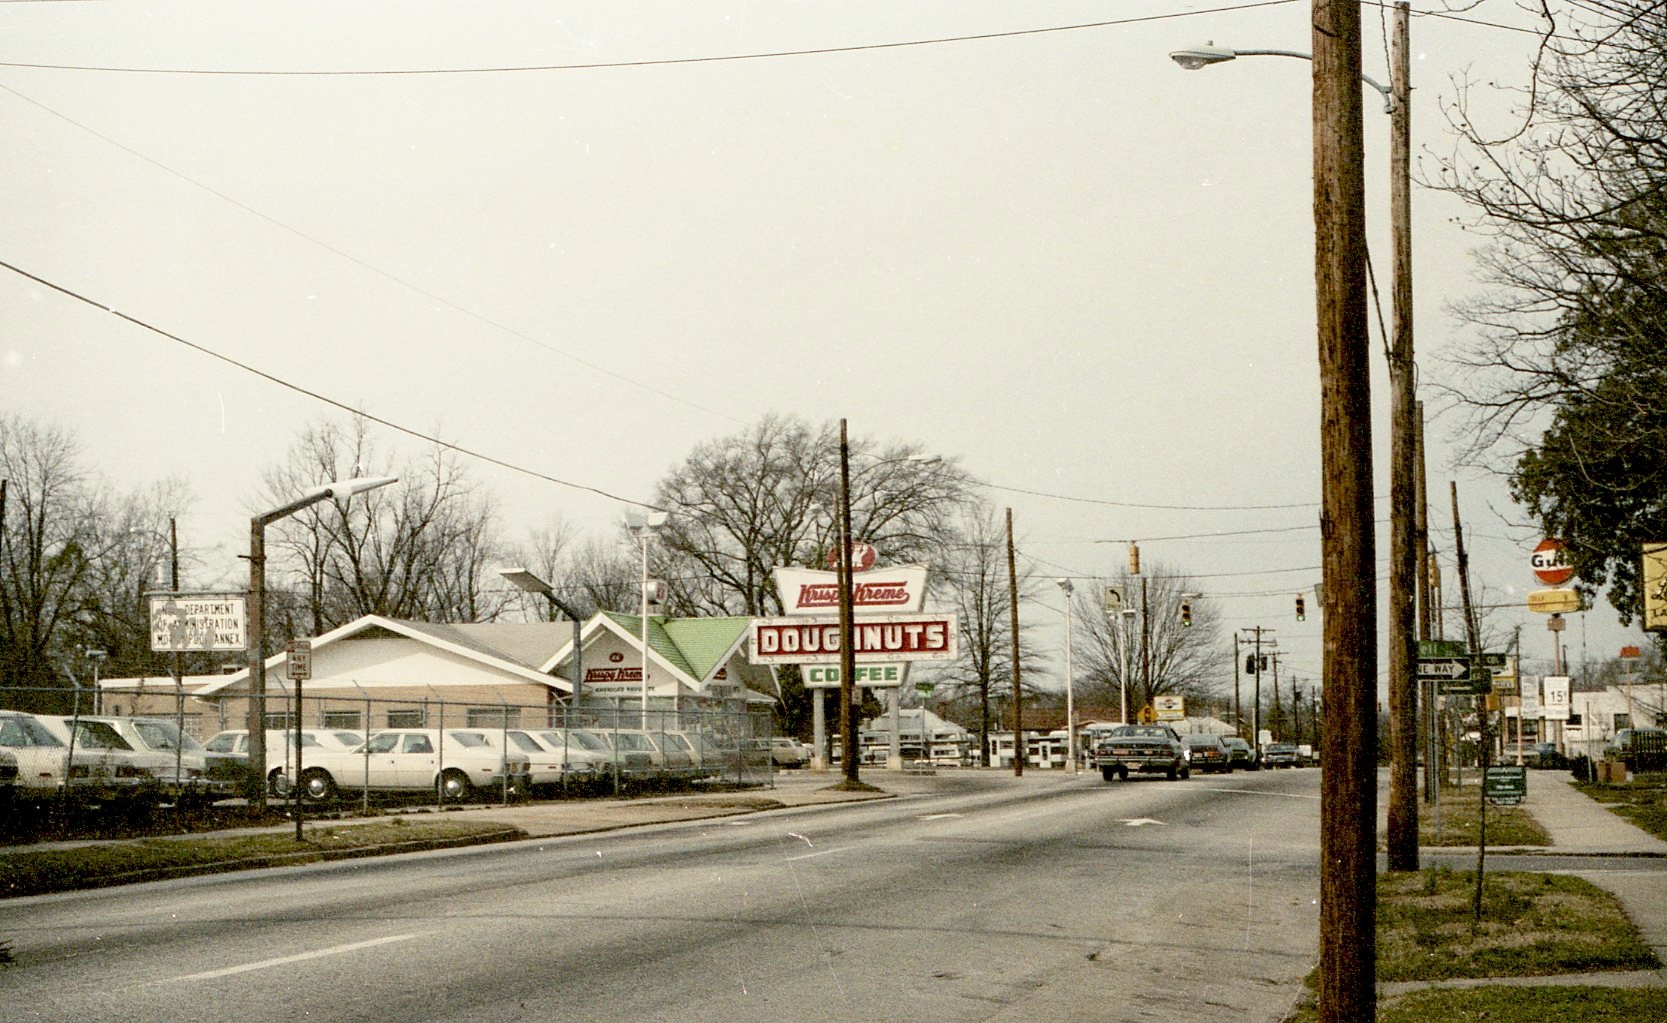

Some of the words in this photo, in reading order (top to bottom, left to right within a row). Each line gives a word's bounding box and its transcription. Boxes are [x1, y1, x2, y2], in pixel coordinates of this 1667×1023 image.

[796, 583, 840, 608] Krisp
[853, 580, 910, 606] Kreme
[185, 603, 234, 615] DEPARTMENT
[214, 633, 240, 645] ANNEX
[617, 667, 650, 682] Krem
[809, 666, 898, 683] COFEE
[1418, 665, 1429, 674] NE
[1434, 664, 1455, 674] WAY
